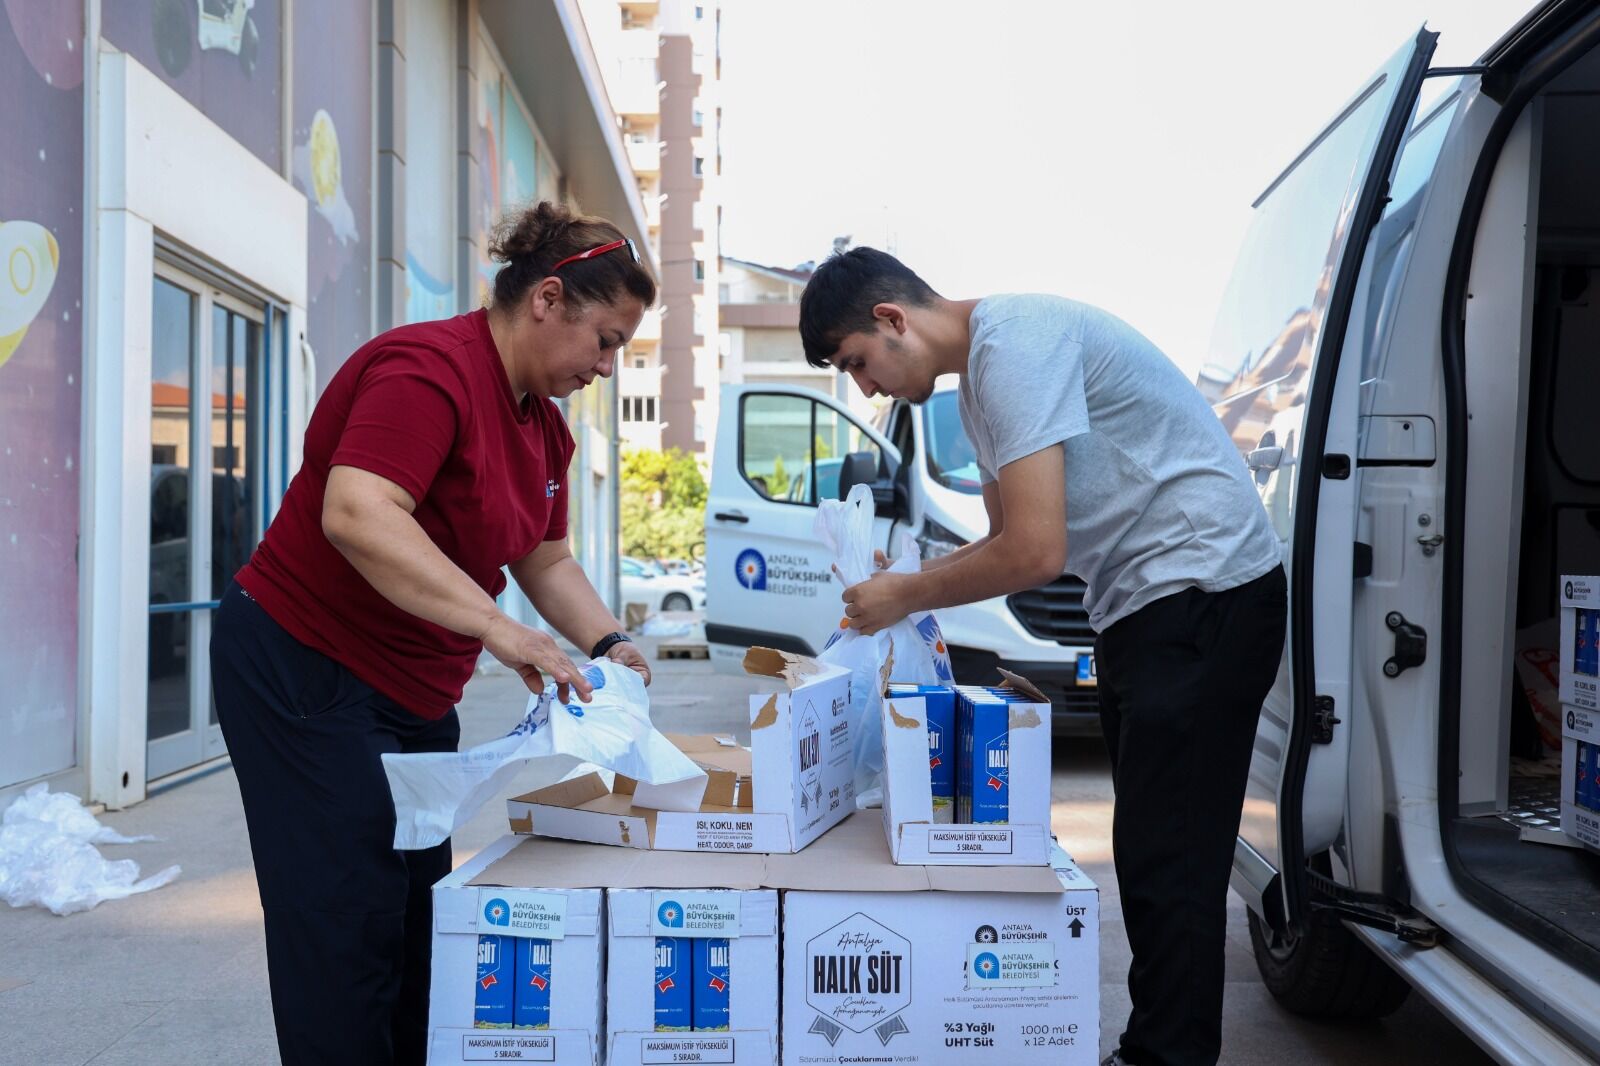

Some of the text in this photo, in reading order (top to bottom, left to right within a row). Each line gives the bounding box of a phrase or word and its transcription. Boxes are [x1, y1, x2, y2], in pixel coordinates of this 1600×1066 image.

[768, 555, 808, 566] ANTALYA
[768, 566, 832, 584] BÜYÜKŞEHİR
[768, 584, 816, 597] BELEDİYESİ
[710, 821, 734, 830] KOKU,
[736, 822, 752, 830] NEM
[934, 832, 1007, 841] MAKSİMUM İSTİF YÜKSEKLİĞİ
[514, 902, 546, 911] ANTALYA
[1066, 906, 1086, 916] ÜST
[512, 910, 560, 922] BÜYÜKŞEHİR
[686, 911, 735, 921] BÜYÜKŞEHİR
[512, 920, 550, 930] BELEDİYESİ
[686, 921, 724, 930] BELEDİYESİ
[1002, 931, 1047, 940] BÜYÜKŞEHİR
[838, 932, 882, 953] Antalya
[478, 941, 496, 964] SÜT
[656, 945, 672, 967] SÜT
[1002, 960, 1049, 971] BÜYÜKŞEHİR
[814, 951, 902, 994] HALK SÜT
[944, 1022, 995, 1035] %3 Yağlı
[1022, 1025, 1048, 1034] 1000
[1052, 1024, 1065, 1034] ml
[468, 1038, 549, 1048] MAKSİMUM İSTİF YÜKSEKLİĞİ
[647, 1040, 728, 1051] MAKSİMUM İSTİF YÜKSEKLİĞİ
[945, 1037, 994, 1047] UHT Süt
[1033, 1037, 1045, 1046] 12
[1048, 1036, 1074, 1046] Adet
[839, 1056, 893, 1064] Çocuklarımıza
